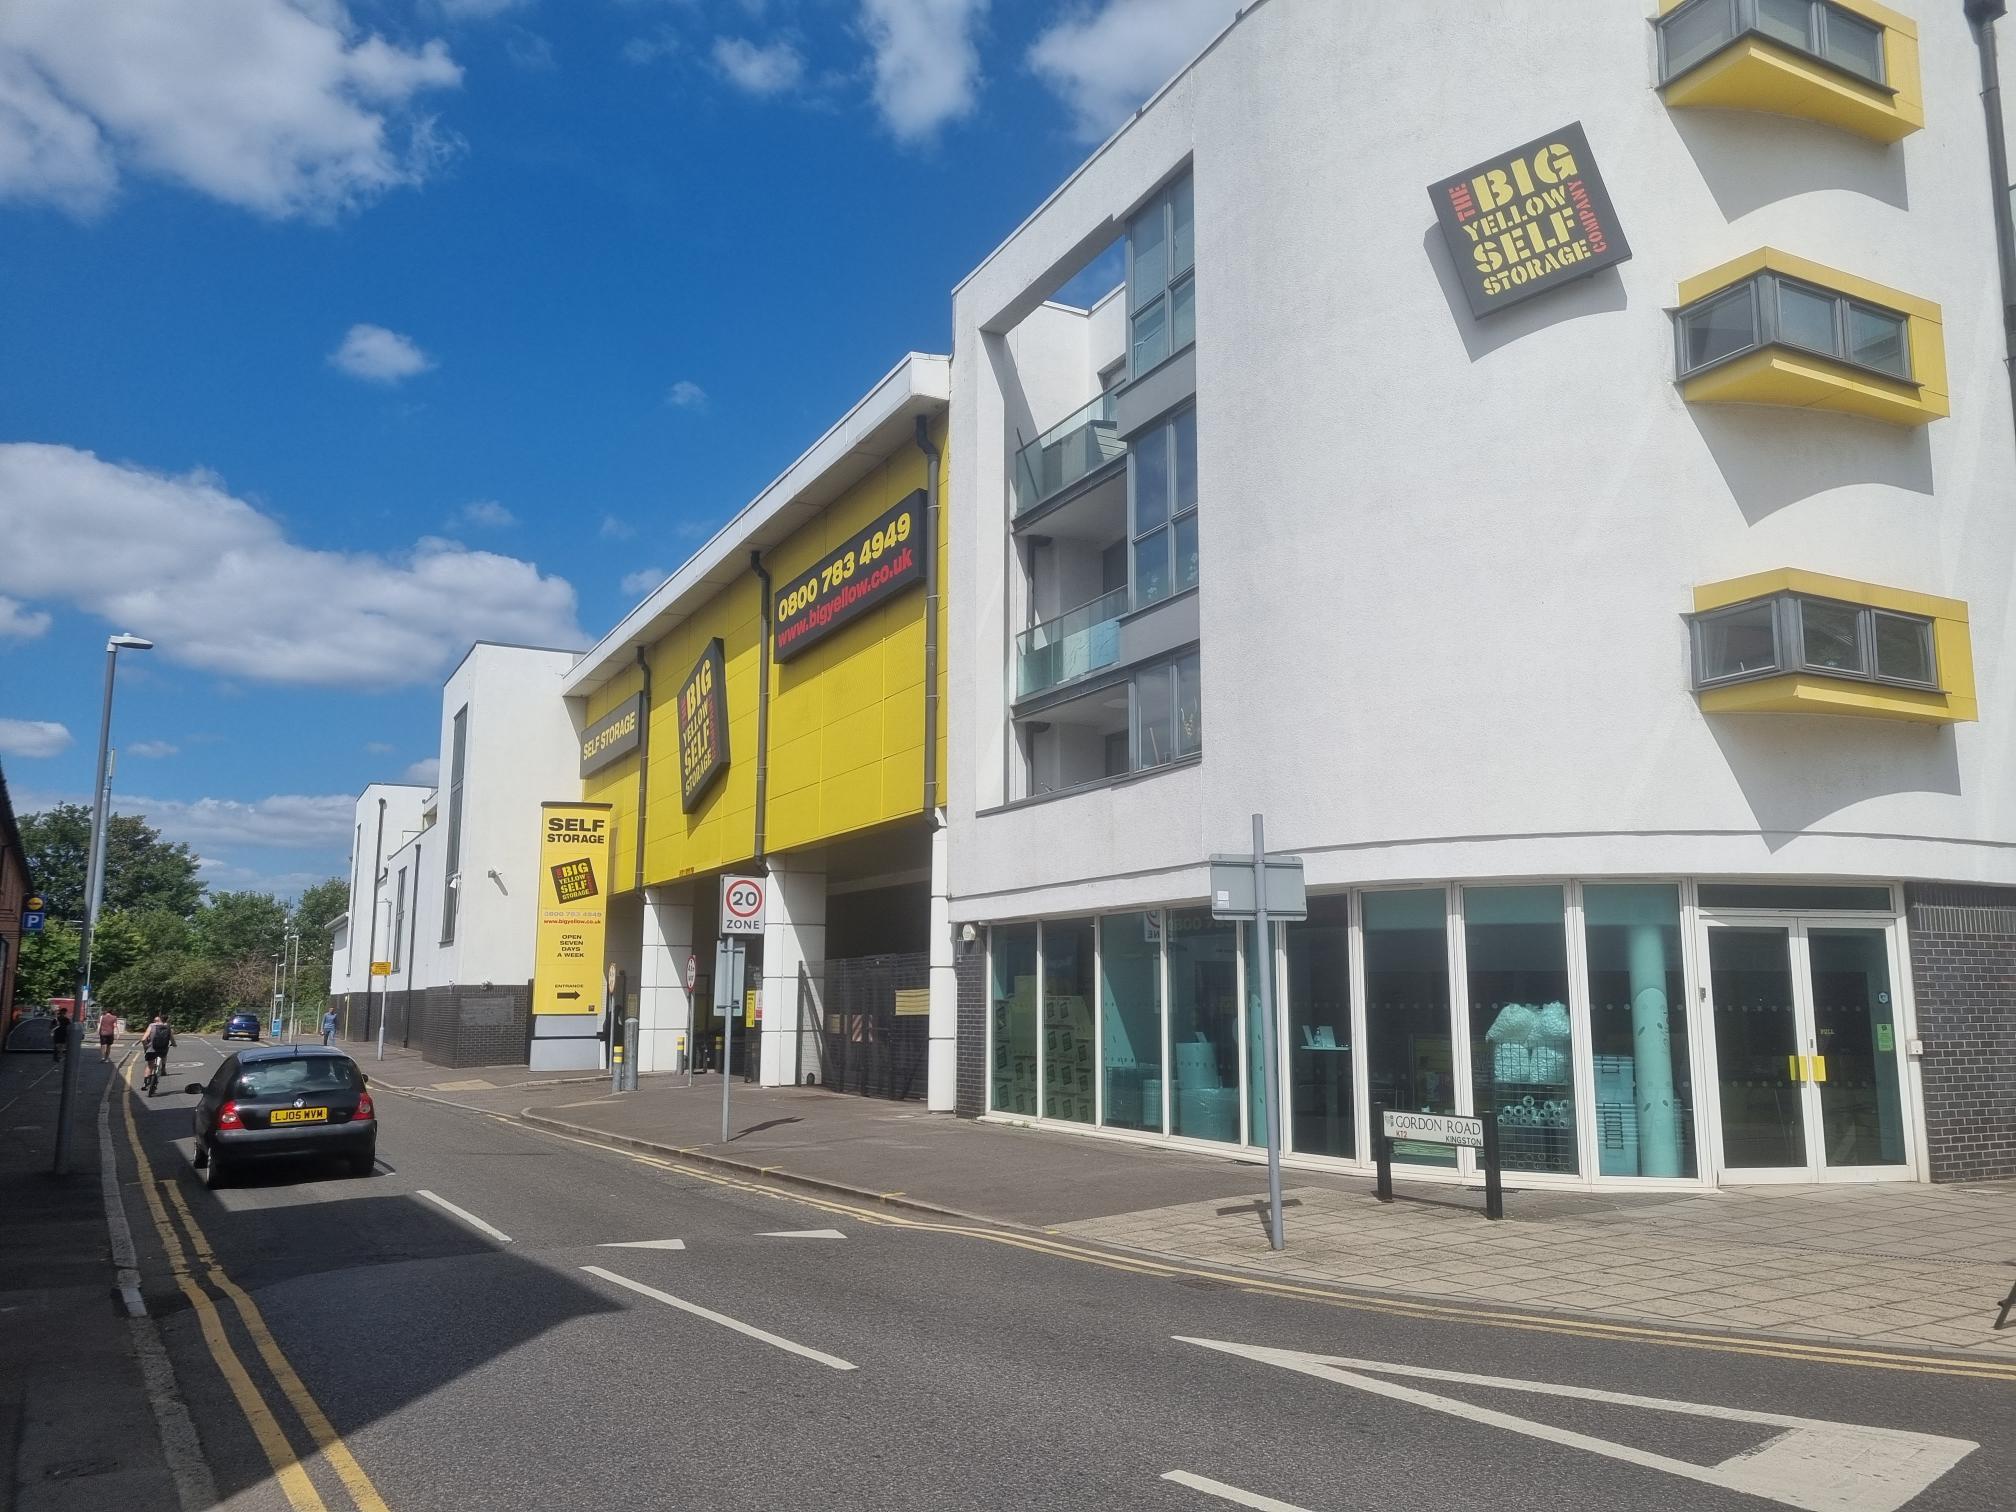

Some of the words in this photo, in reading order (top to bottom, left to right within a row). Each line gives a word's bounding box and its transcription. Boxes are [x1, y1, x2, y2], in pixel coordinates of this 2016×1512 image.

[1472, 144, 1578, 212] BIG
[1449, 183, 1475, 221] THE
[1462, 185, 1567, 241] YELLOW
[1568, 180, 1607, 252] COMPANY
[1473, 208, 1575, 272] SELF
[1483, 239, 1592, 295] STORAGE
[778, 578, 818, 622] 0800
[822, 551, 855, 594] 783
[859, 513, 911, 565] 4949
[778, 547, 912, 647] www.bigyellow.co.uk
[686, 659, 712, 722] BIG
[583, 734, 601, 760] SELF
[600, 712, 636, 749] STORAGE
[683, 698, 709, 747] YELLOW
[684, 719, 710, 775] SELF
[685, 751, 712, 796] STORAGE
[547, 833, 605, 844] STORAGE
[548, 817, 605, 832] SELF
[559, 874, 586, 885] YELLOW
[562, 862, 589, 877] BIG
[560, 880, 587, 894] SELF
[562, 889, 591, 900] STORAGE
[732, 891, 757, 906] 20
[27, 915, 40, 928] P
[726, 919, 760, 930] ZONE
[276, 1111, 301, 1120] LJ05
[1395, 1115, 1442, 1131] GORDON
[1447, 1120, 1481, 1135] ROAD
[1395, 1130, 1408, 1138] KT2
[1445, 1135, 1482, 1146] KINGSTON
